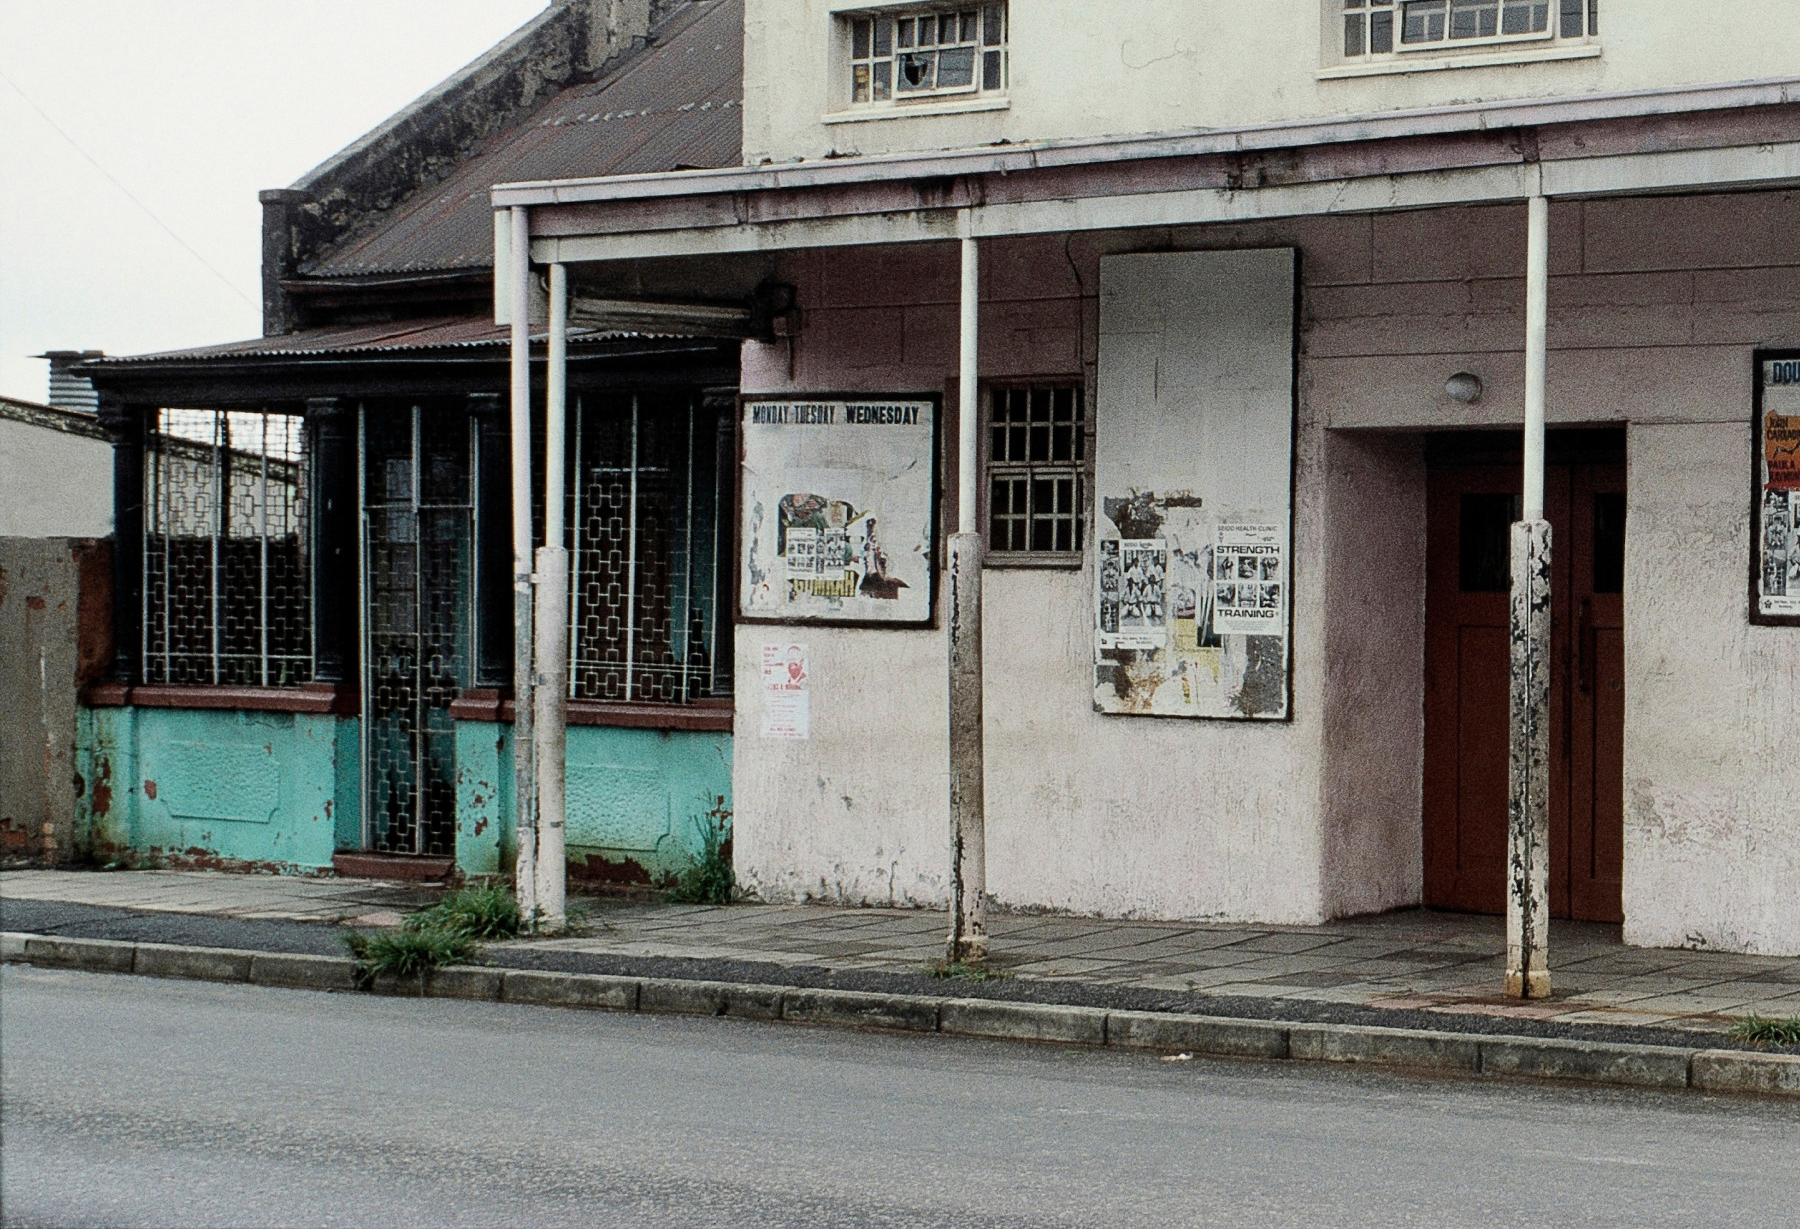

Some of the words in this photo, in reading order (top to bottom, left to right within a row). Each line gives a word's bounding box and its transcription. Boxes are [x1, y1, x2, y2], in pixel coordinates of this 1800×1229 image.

[752, 405, 789, 425] MONDAY
[794, 405, 836, 425] TUESDAY
[846, 405, 920, 425] WEDNESDAY
[1216, 545, 1280, 554] STRENGTH
[1217, 609, 1274, 618] TRAINING
